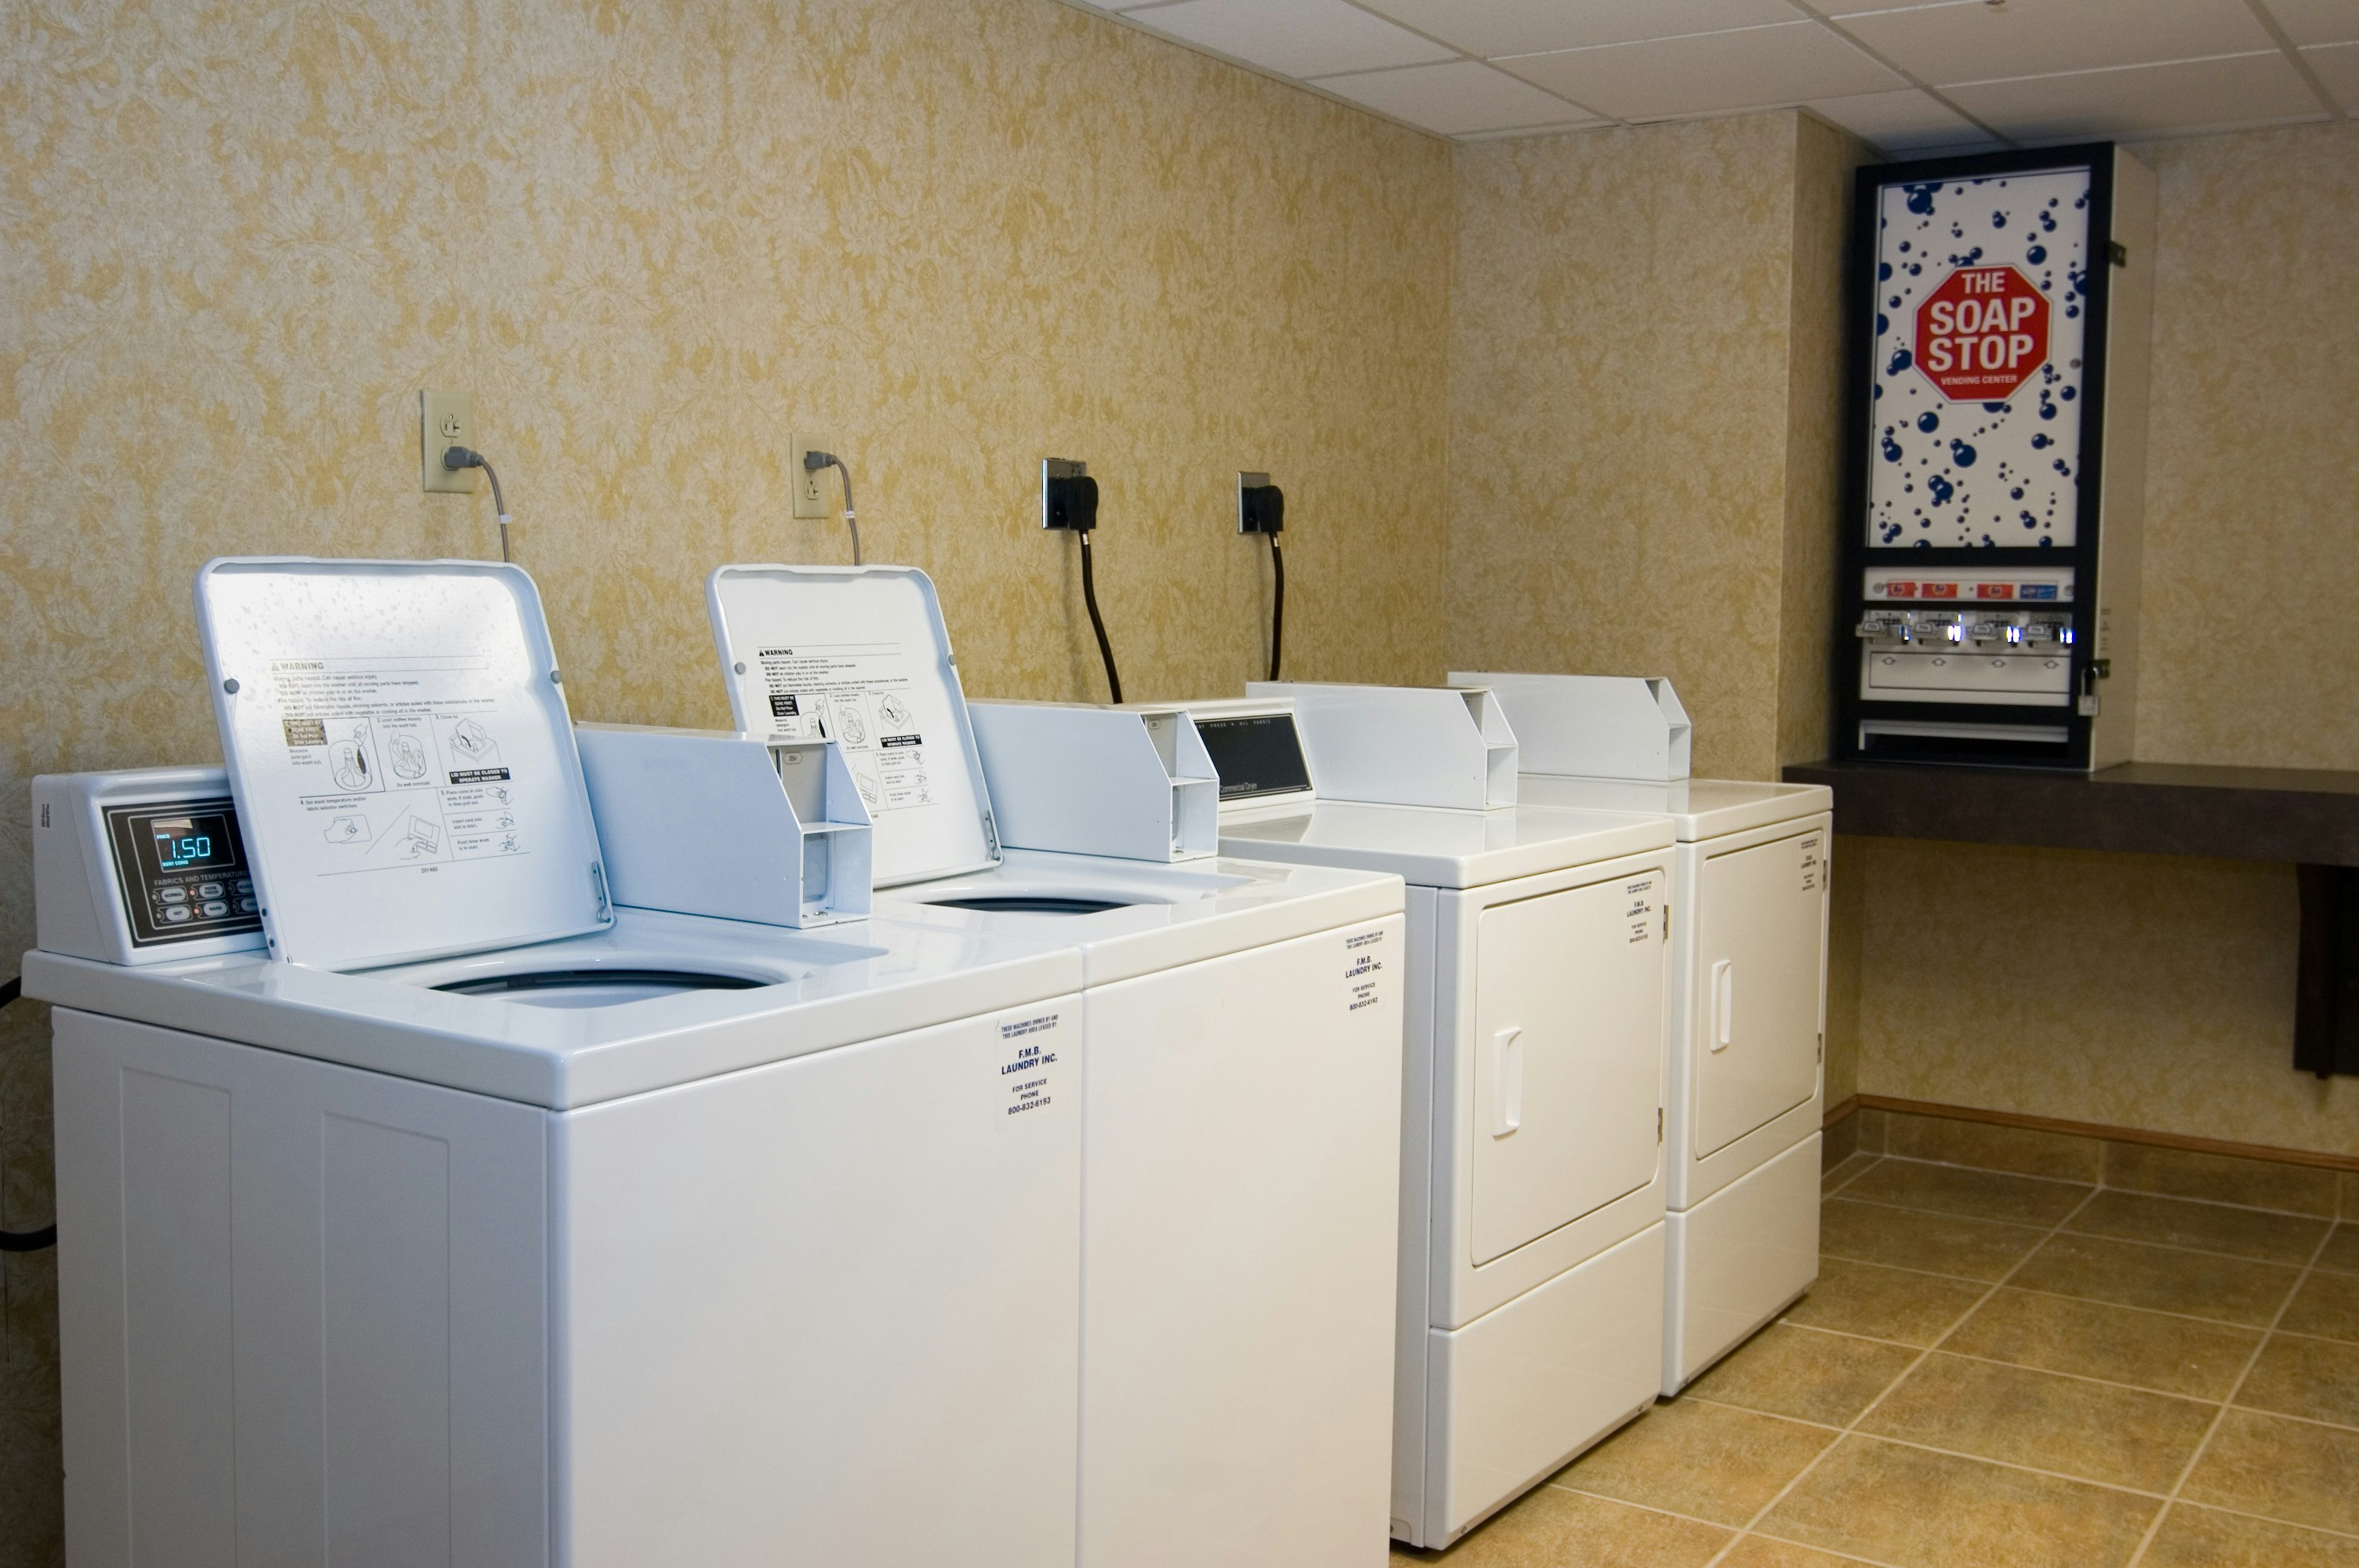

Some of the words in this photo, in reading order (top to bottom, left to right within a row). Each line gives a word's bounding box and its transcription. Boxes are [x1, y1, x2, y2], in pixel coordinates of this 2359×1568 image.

[1961, 271, 2006, 294] THE
[1929, 296, 2036, 336] SOAP
[1928, 334, 2034, 372] STOP
[1941, 376, 1980, 386] VENDING
[1982, 374, 2018, 384] CENTER
[1219, 782, 1245, 793] Commercial
[1245, 782, 1258, 792] Dryer
[172, 837, 210, 858] 1.50
[154, 877, 184, 886] FABRICS
[1345, 965, 1371, 978] LAUNDRY
[1361, 982, 1376, 991] SERVICE
[1011, 1028, 1028, 1038] LAUNDRY
[1038, 1023, 1052, 1032] LEASED
[1013, 1020, 1032, 1031] MACHINES
[1032, 1017, 1045, 1026] OWNED
[1018, 1046, 1041, 1059] F.M.B.
[1001, 1058, 1040, 1076] LAUNDRY
[1041, 1053, 1058, 1065] INC.
[1012, 1084, 1023, 1093] FOR
[1024, 1078, 1047, 1090] SERVICE
[1020, 1090, 1039, 1101] PHONE
[1008, 1096, 1051, 1115] 800-832-6193
